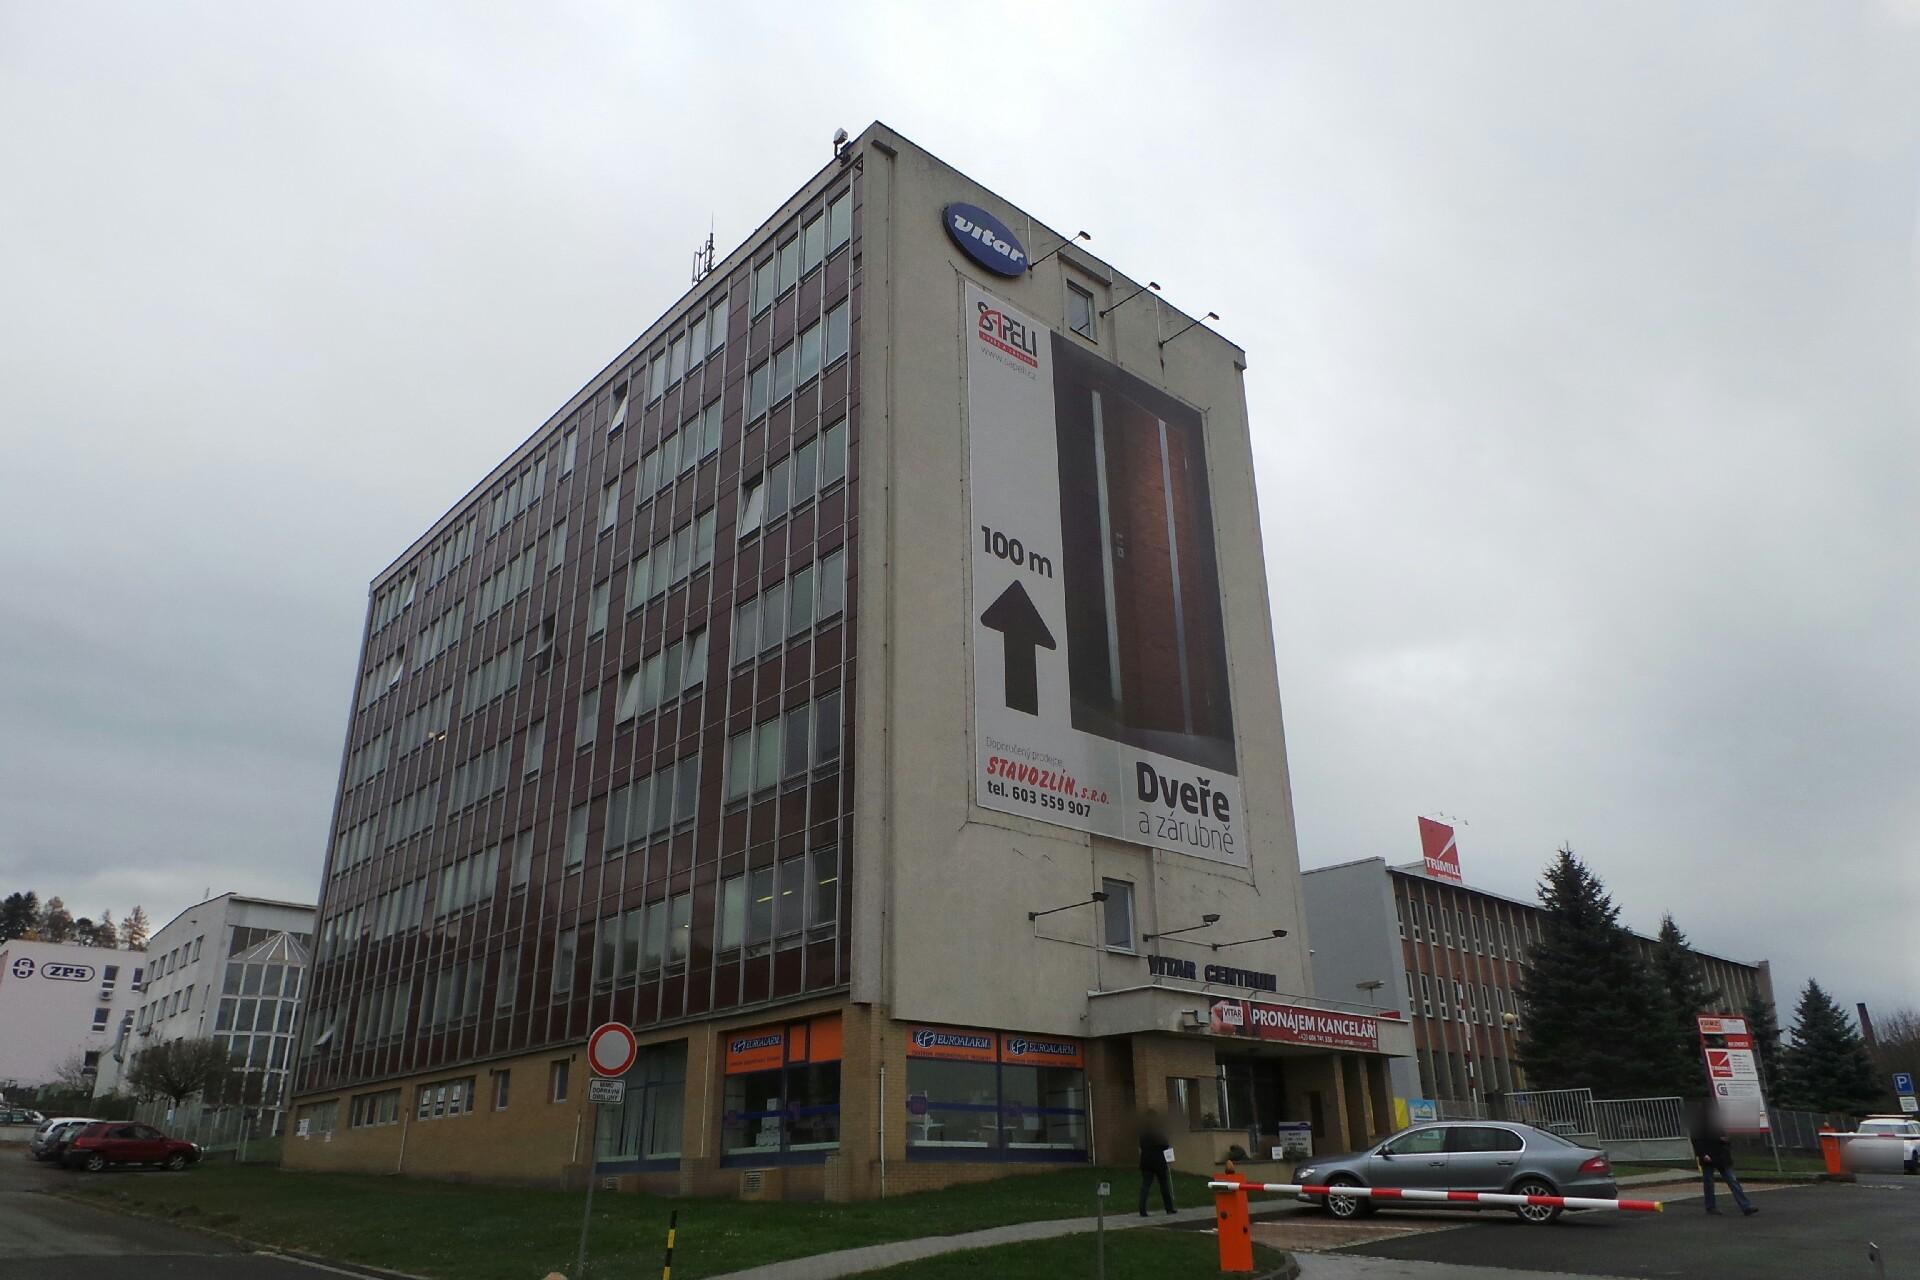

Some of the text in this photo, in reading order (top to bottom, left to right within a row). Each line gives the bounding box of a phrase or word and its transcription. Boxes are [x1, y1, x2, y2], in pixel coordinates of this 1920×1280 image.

[954, 214, 1024, 262] vitar
[978, 301, 1037, 357] SAPELI
[981, 525, 1052, 578] 100 m
[987, 780, 1091, 818] tel. 603 559 907
[1136, 761, 1230, 822] Dveře
[1139, 810, 1234, 855] a zárubně
[1424, 856, 1461, 876] TRIMILL
[49, 966, 87, 978] ZPS
[1147, 954, 1277, 992] VITAR CENTRUM
[1223, 1006, 1242, 1018] VITAR
[1252, 1008, 1377, 1039] PRONÁJEM KANCELÁŘÍ
[746, 1036, 779, 1048] EUROALARM
[937, 1034, 988, 1048] EUROALARM
[1028, 1042, 1074, 1054] EUROALARM
[1896, 1076, 1907, 1088] P
